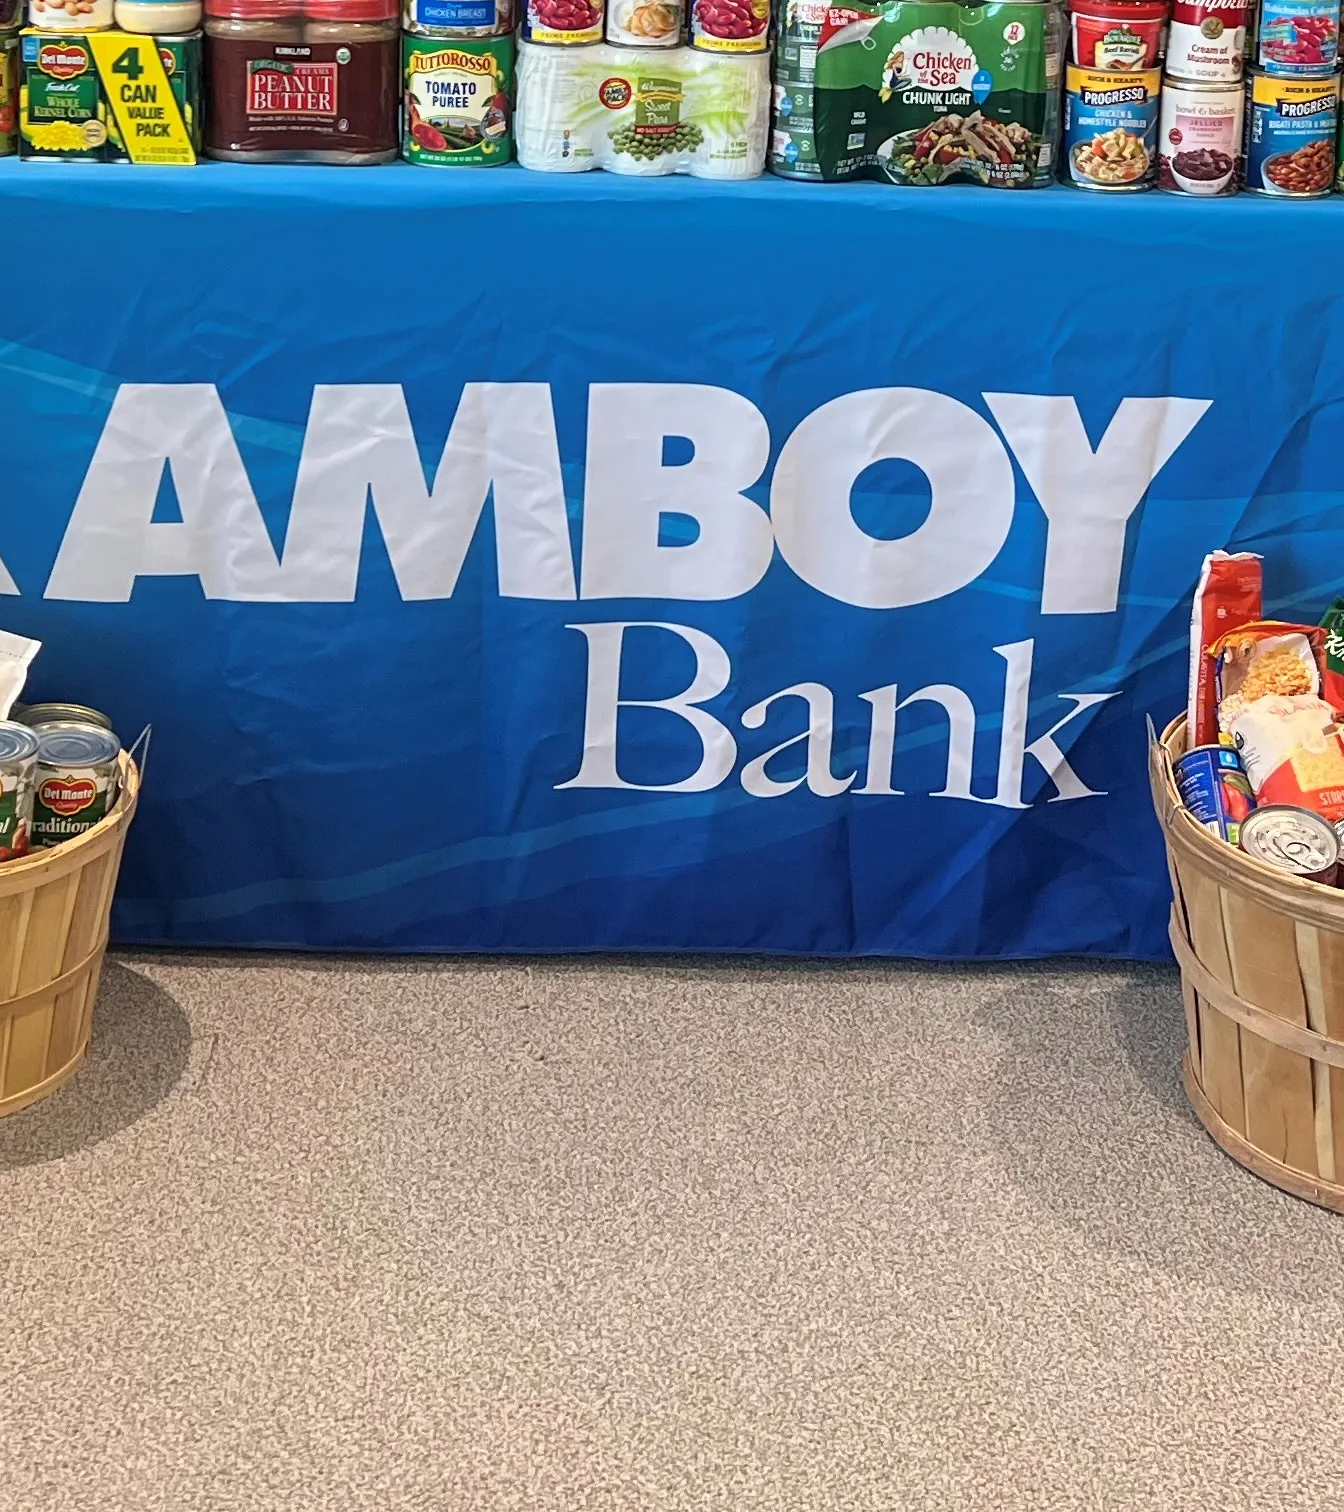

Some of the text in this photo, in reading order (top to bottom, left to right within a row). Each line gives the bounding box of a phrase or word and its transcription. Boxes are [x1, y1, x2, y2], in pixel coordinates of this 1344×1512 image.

[1191, 44, 1216, 55] Cream
[111, 46, 144, 81] 4
[413, 52, 492, 71] TUTTOROSSO
[912, 51, 973, 72] Chicken
[1187, 53, 1230, 66] Mushroom
[253, 73, 334, 93] PEANUT
[929, 70, 958, 87] Sea
[120, 84, 157, 104] CAN
[425, 80, 477, 96] TOMATO
[1083, 87, 1145, 106] PROGRESSO
[253, 91, 332, 111] BUTTER
[431, 95, 470, 109] PUREE
[902, 91, 972, 106] CHUNK LIGHT
[126, 106, 165, 120] VALUE
[135, 122, 171, 138] PACK
[43, 381, 1215, 615] AMBOY
[553, 619, 1126, 809] Bank
[43, 786, 93, 802] Del Monte
